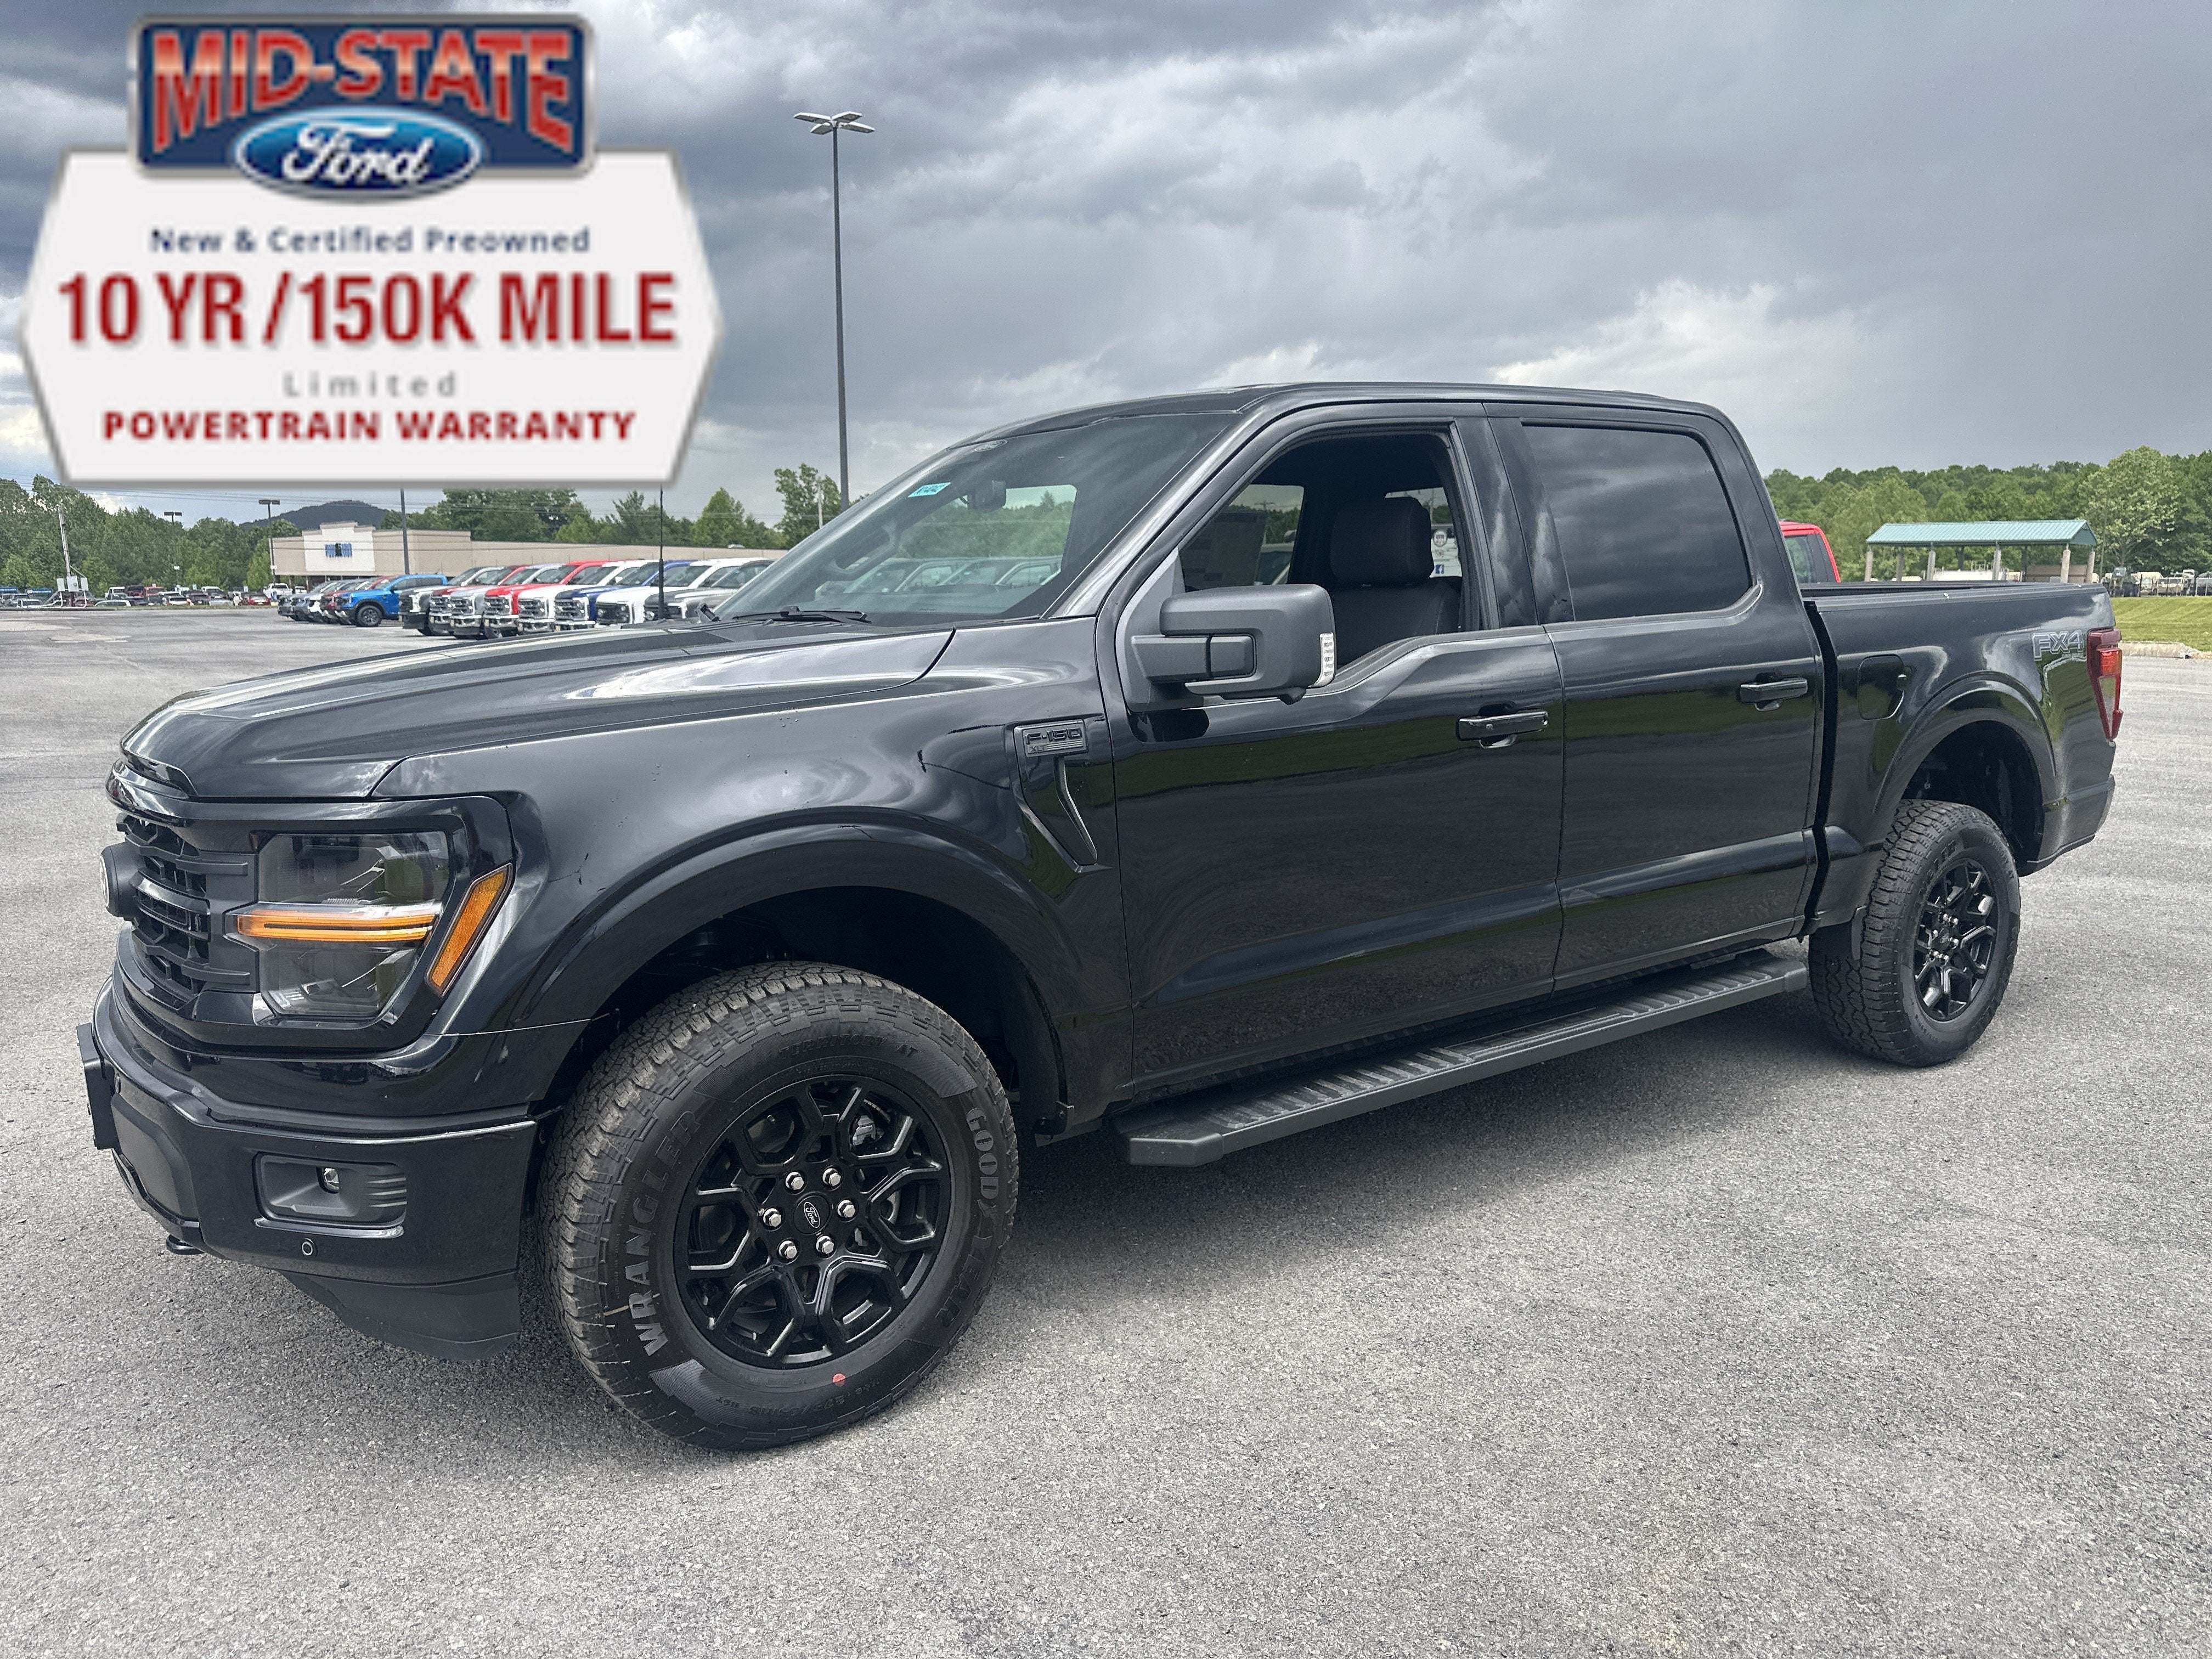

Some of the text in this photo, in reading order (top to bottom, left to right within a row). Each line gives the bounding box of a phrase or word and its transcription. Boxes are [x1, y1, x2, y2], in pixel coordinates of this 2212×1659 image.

[2032, 630, 2084, 661] FX4
[1024, 727, 1082, 745] F-150
[1030, 744, 1046, 753] XLT
[778, 1034, 919, 1060] TERRITORY AT
[805, 1207, 818, 1224] Ford
[624, 1110, 701, 1357] WRANGLER
